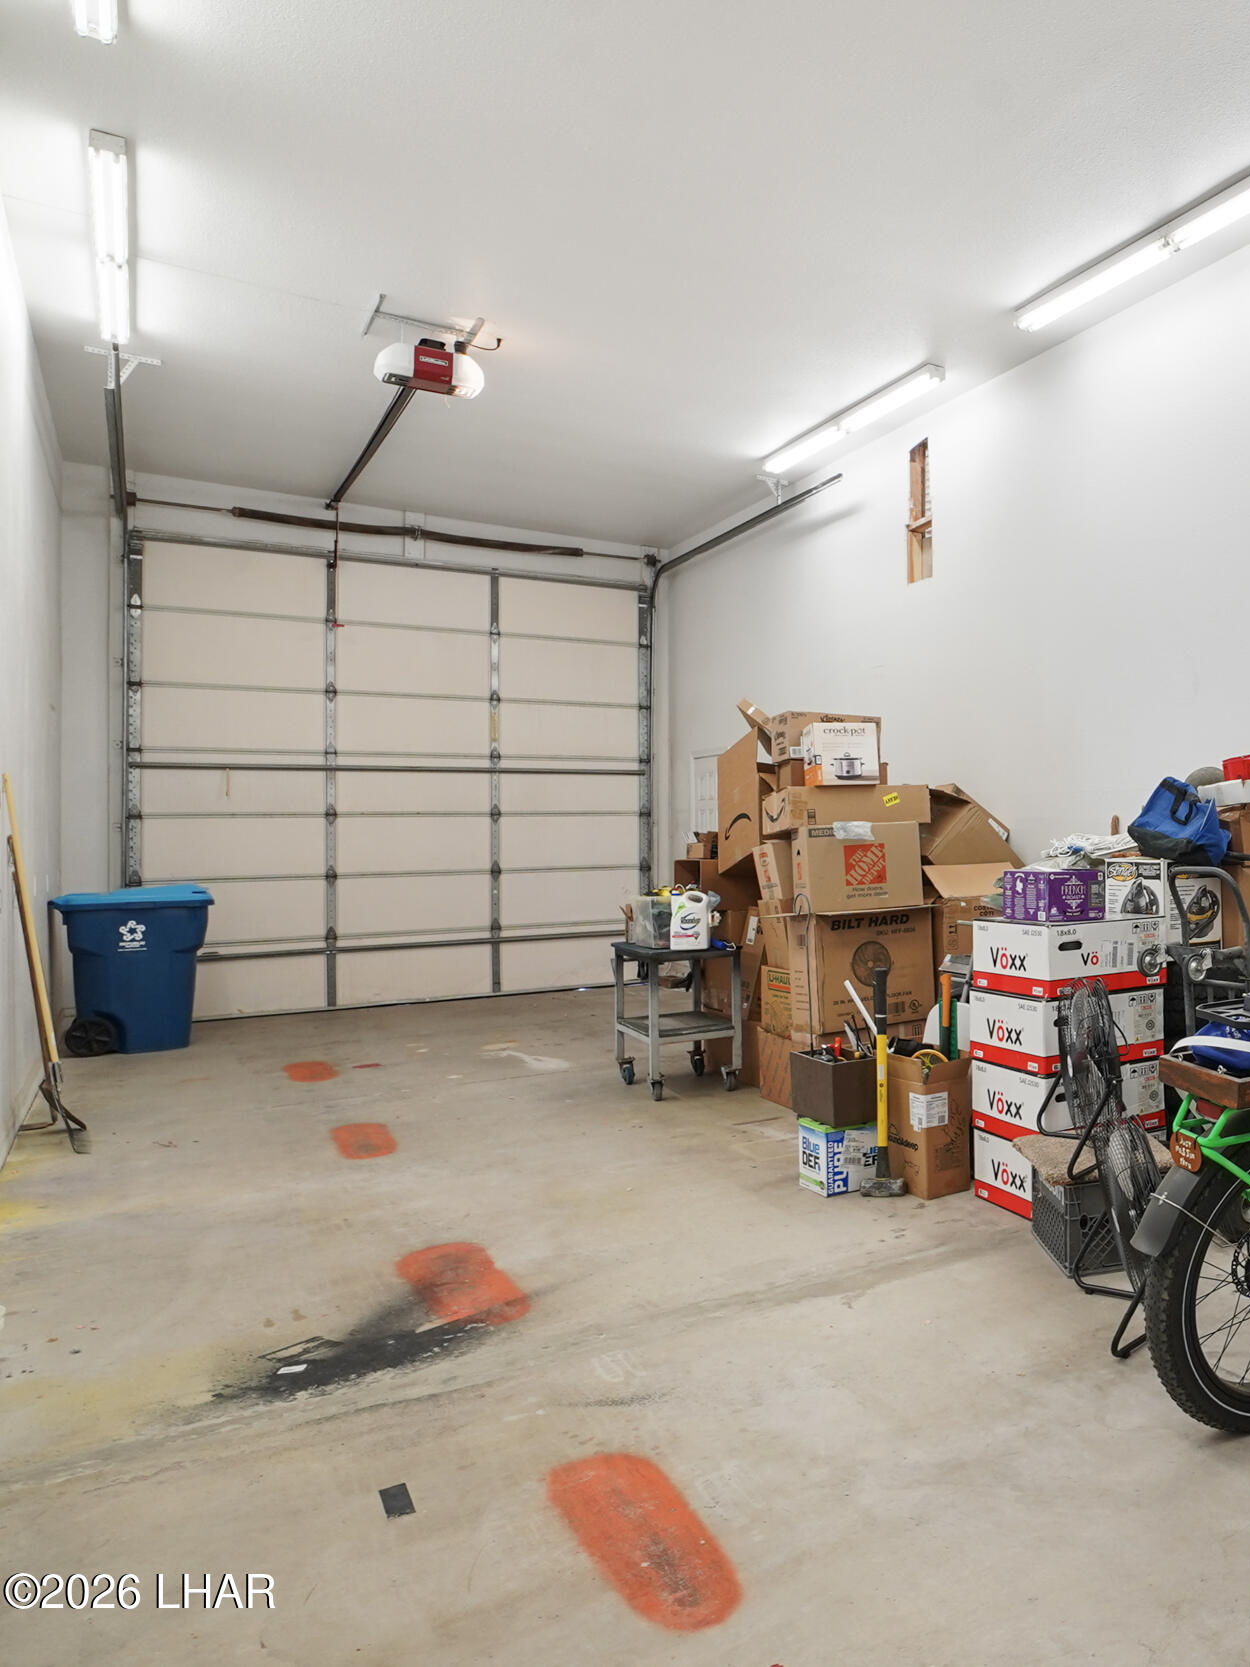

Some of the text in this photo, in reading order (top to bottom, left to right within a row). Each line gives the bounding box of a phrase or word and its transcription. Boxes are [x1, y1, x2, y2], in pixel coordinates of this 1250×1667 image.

[811, 828, 835, 837] MEDI
[846, 843, 885, 886] HOME
[862, 859, 887, 885] DEPOT
[830, 914, 910, 931] BILT HARD
[802, 1136, 820, 1155] Blue
[802, 1151, 820, 1170] DEF
